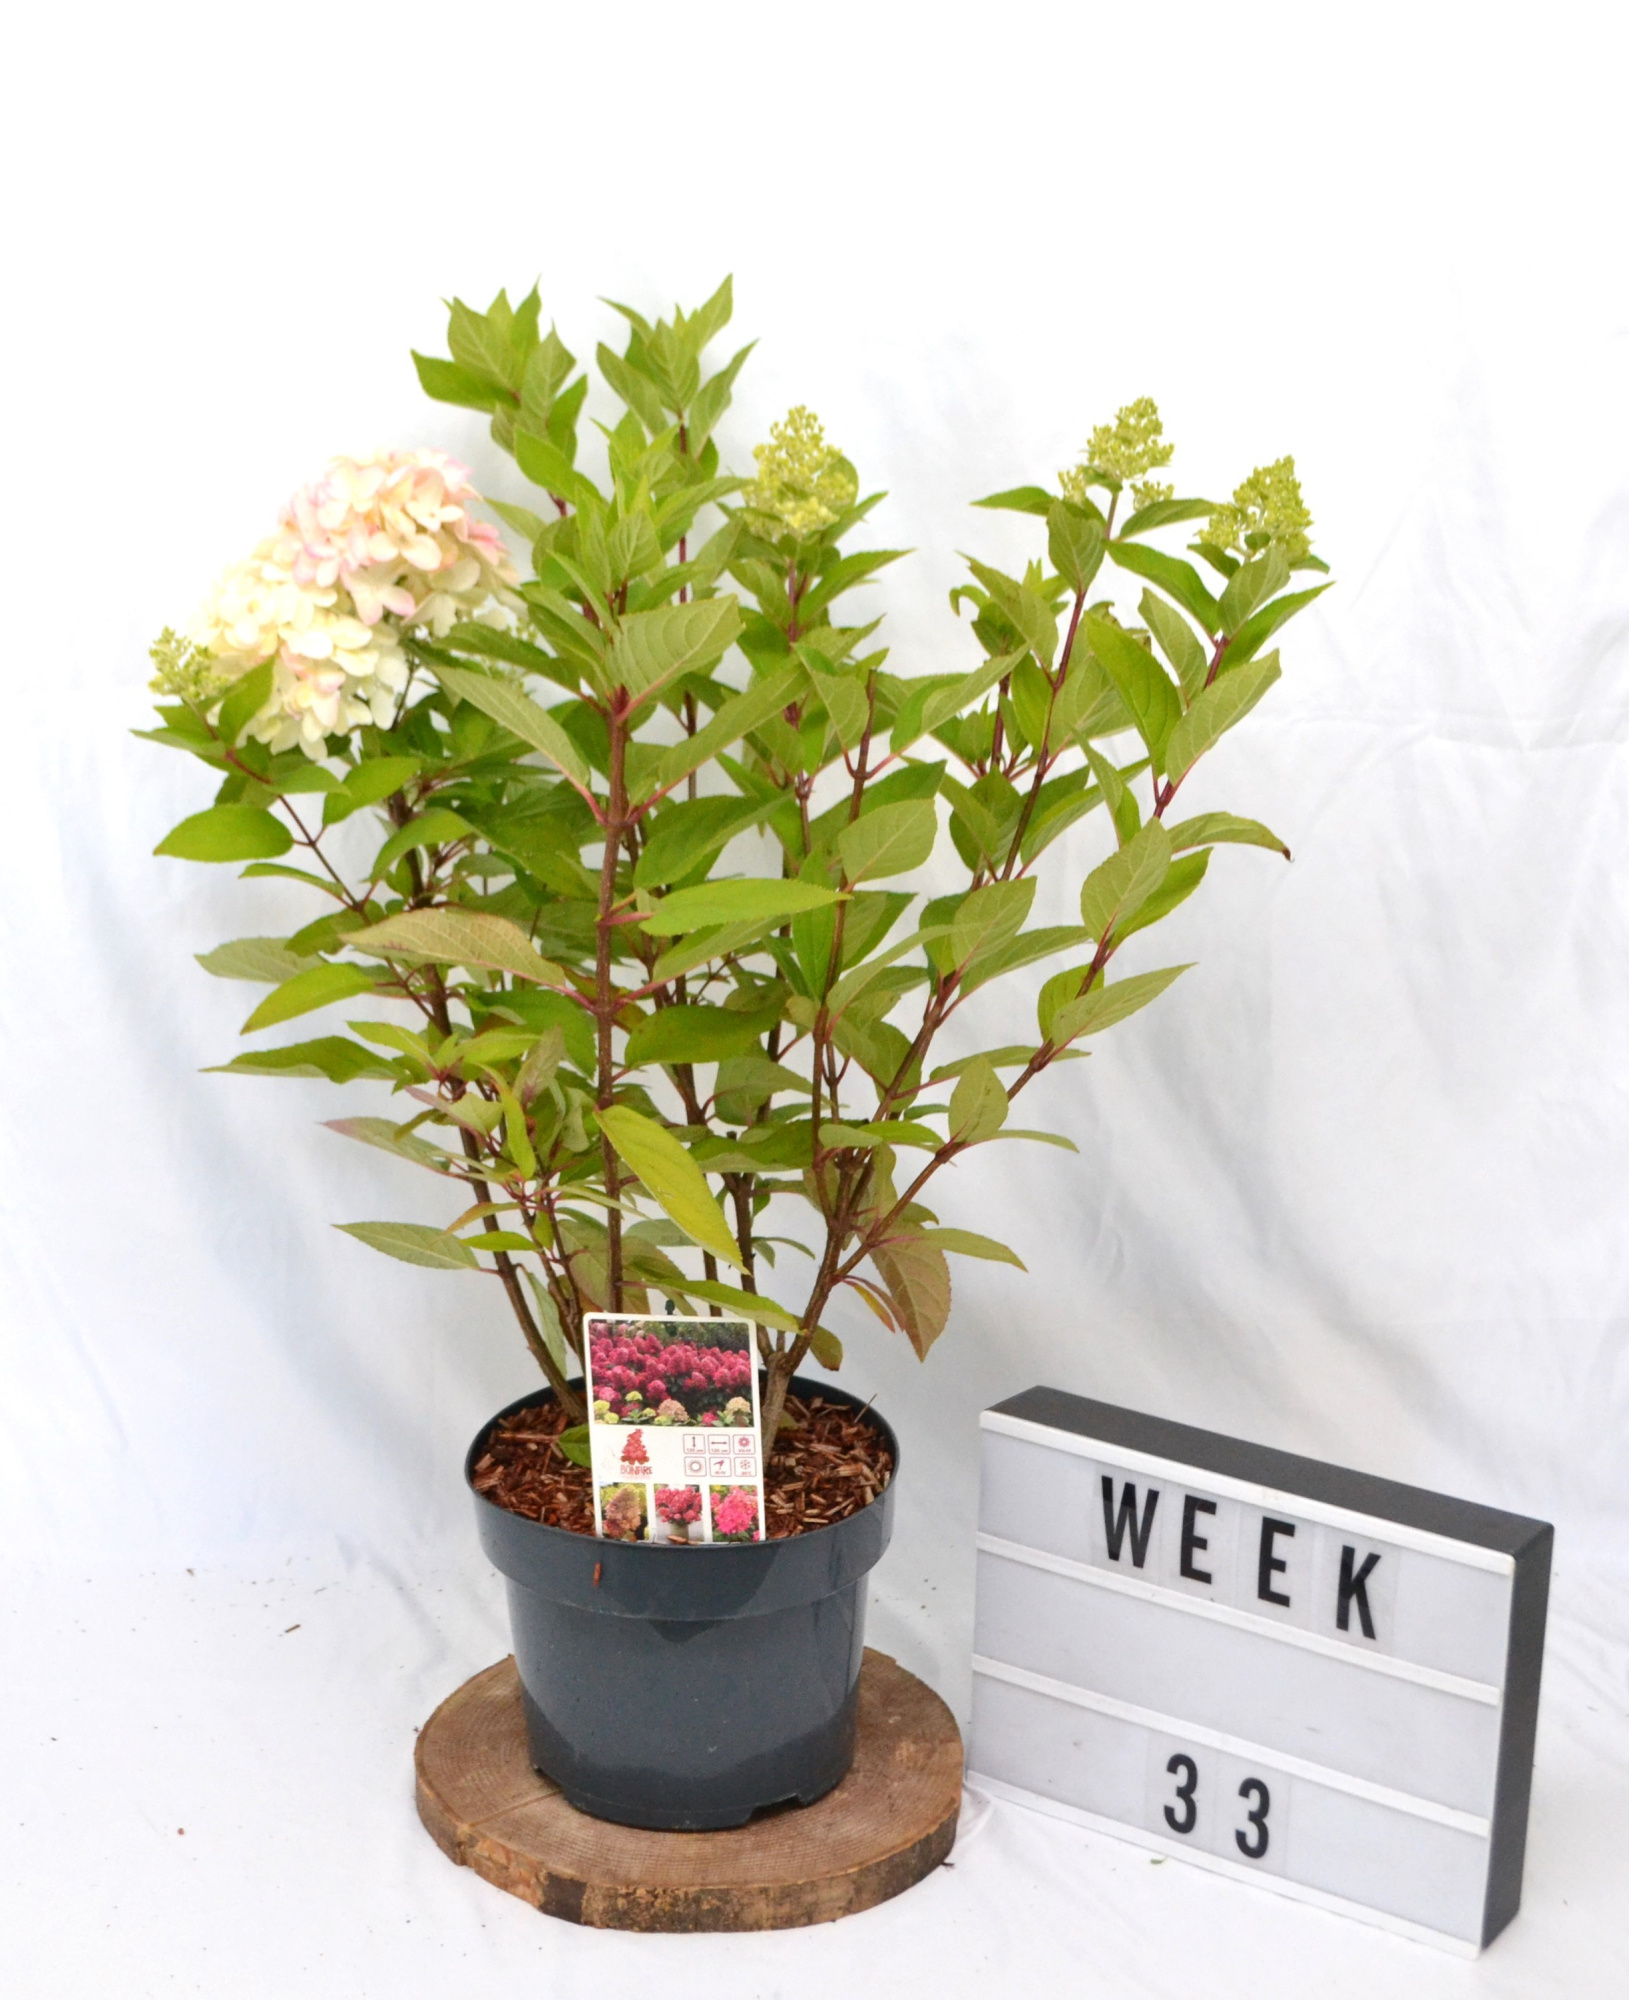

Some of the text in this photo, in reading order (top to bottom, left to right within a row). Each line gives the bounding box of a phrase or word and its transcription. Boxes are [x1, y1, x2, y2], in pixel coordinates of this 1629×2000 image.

[620, 1464, 653, 1475] BONFIRE
[1101, 1475, 1381, 1640] WEEK
[1163, 1753, 1271, 1859] 33
